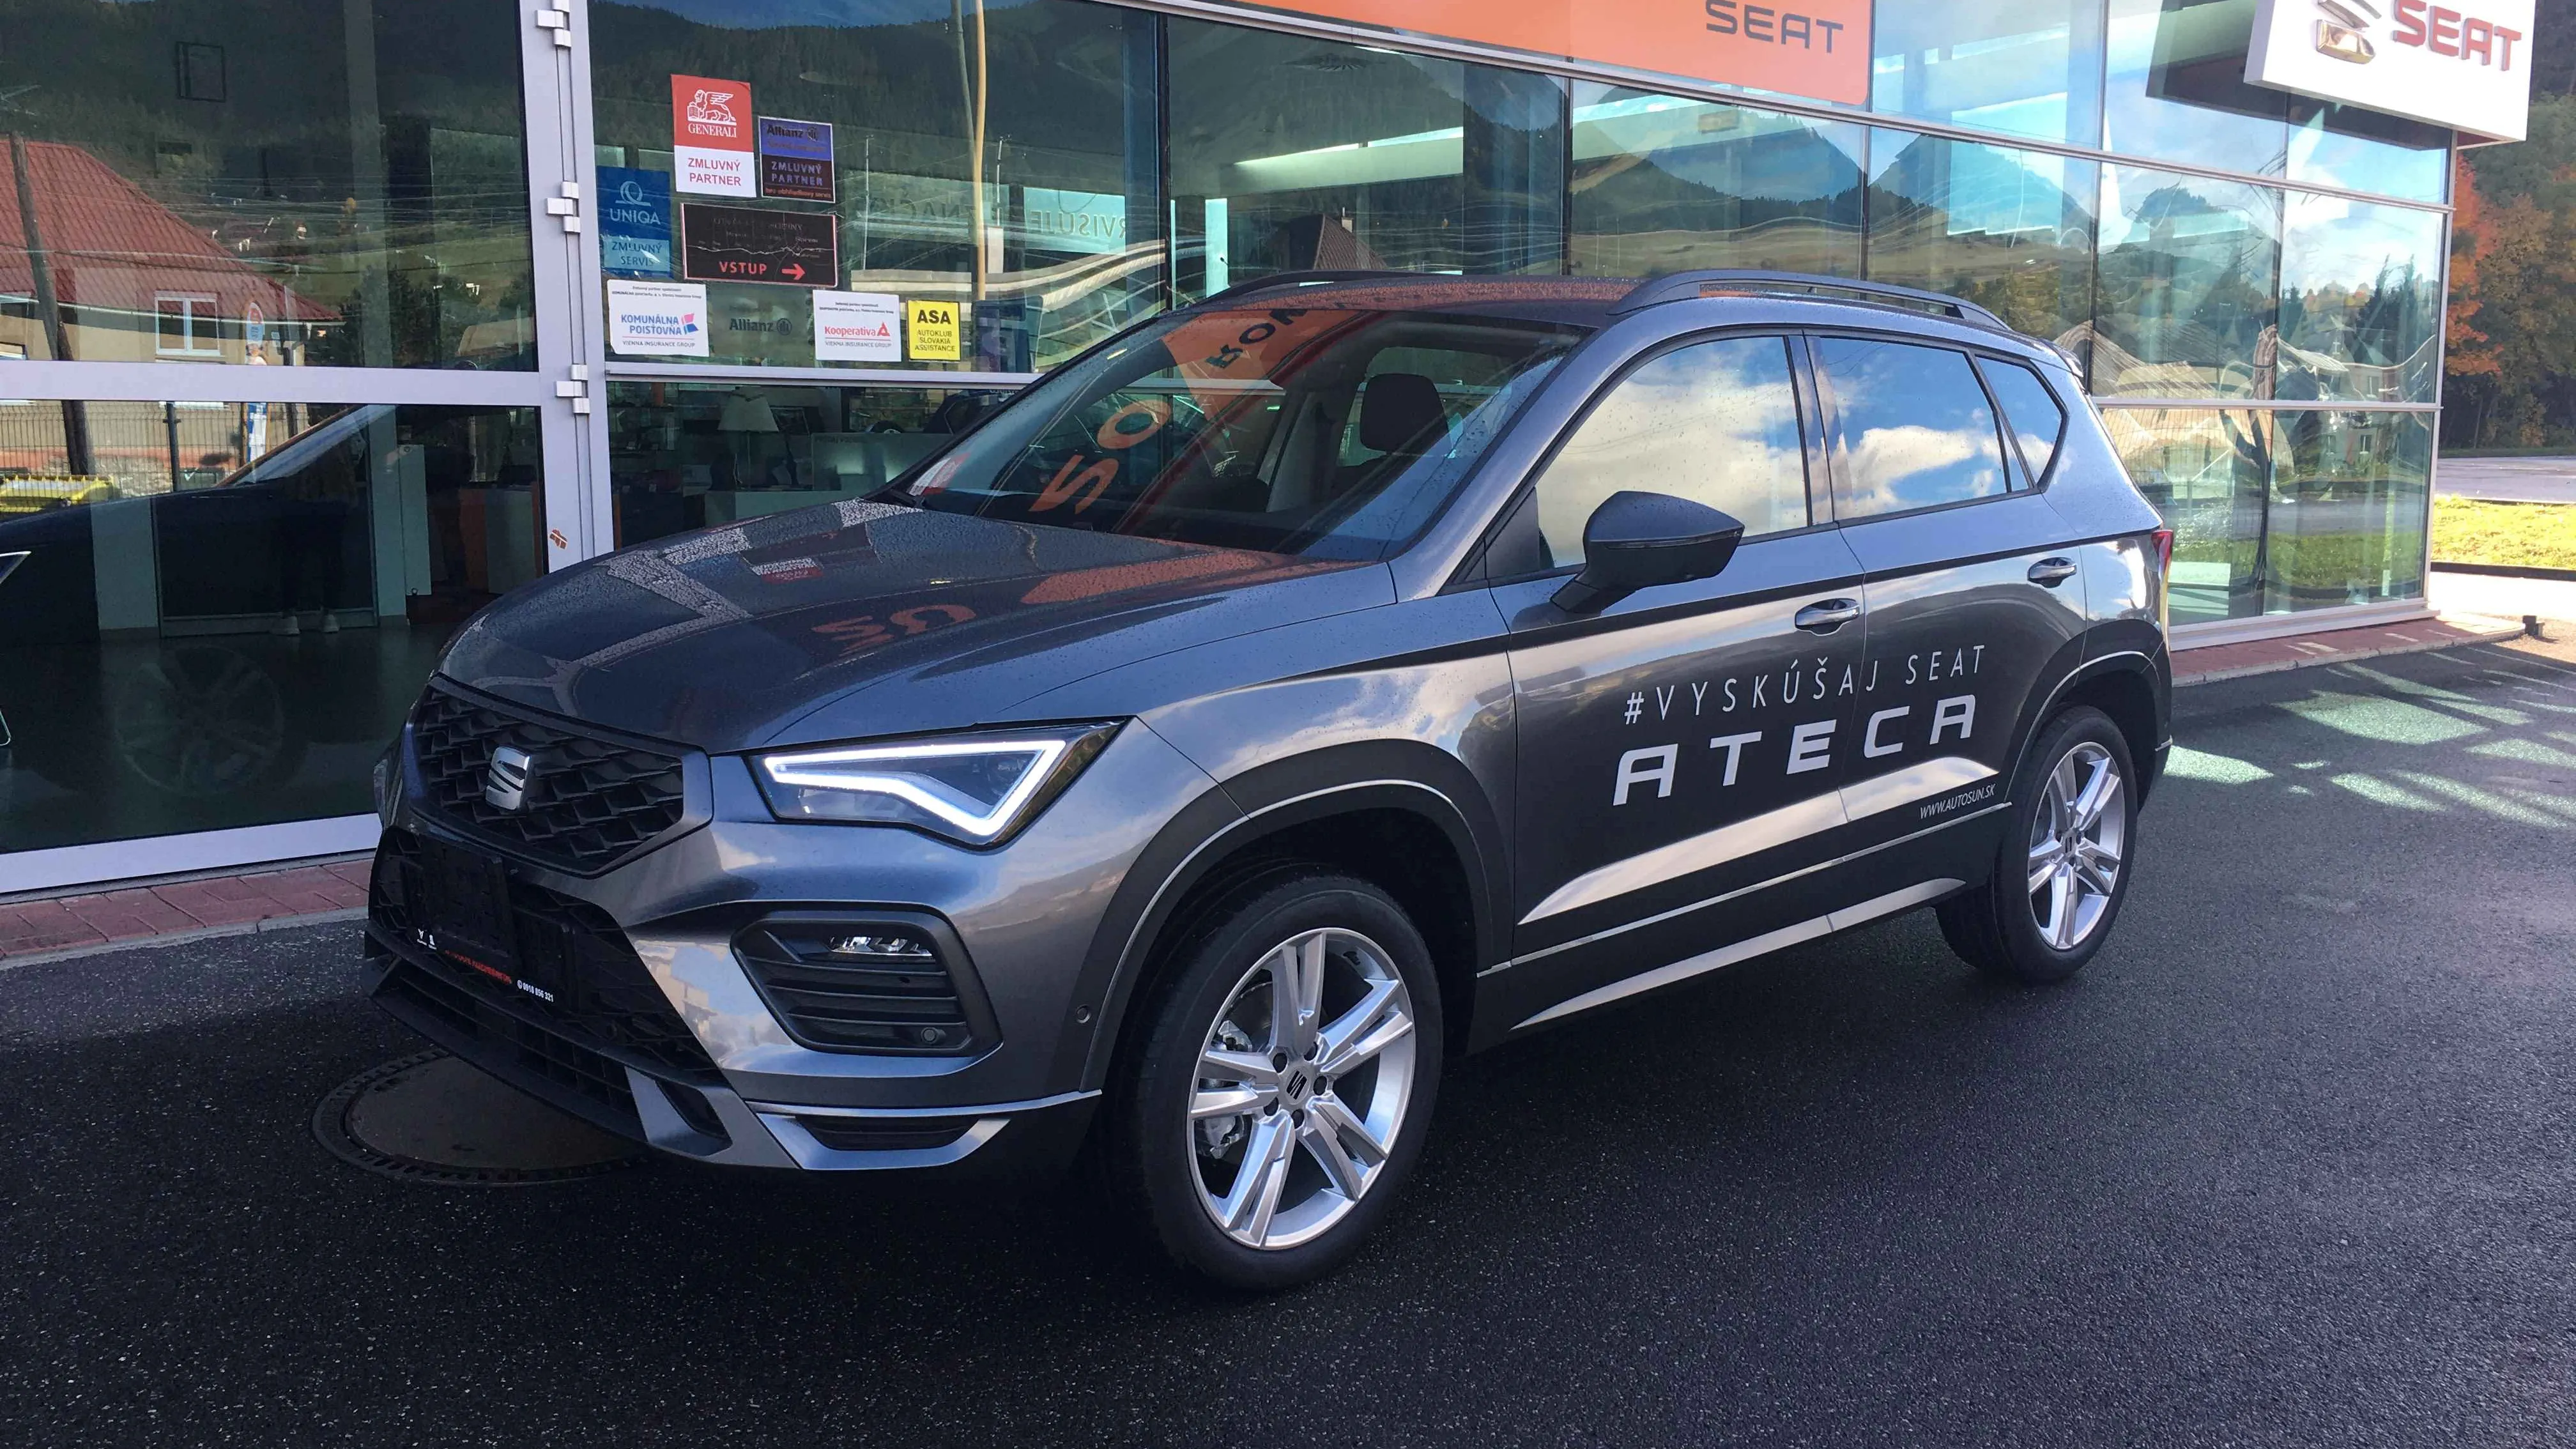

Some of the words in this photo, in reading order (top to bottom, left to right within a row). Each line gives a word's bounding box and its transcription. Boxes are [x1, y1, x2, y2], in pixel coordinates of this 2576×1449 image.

[1706, 0, 1844, 54] SEAT
[2391, 0, 2522, 72] SEAT
[687, 123, 737, 138] GENERALI
[687, 157, 740, 172] ZMLUVNÝ
[771, 161, 822, 174] ZMLUVNÝ
[689, 172, 741, 187] PARTNER
[771, 173, 823, 186] PARTNER
[610, 208, 661, 225] UNIQA
[611, 241, 663, 254] ZMLUVNÝ
[719, 261, 767, 275] VSTUP
[620, 314, 679, 325] KOMUNÁLNA
[917, 309, 952, 325] ASA
[629, 325, 682, 335] POISŤOVŇA
[729, 318, 774, 332] Allianz
[824, 326, 876, 338] Kooperativa
[917, 329, 953, 337] AUTOKLUB
[919, 336, 951, 344] SLOVAKIA
[914, 344, 956, 352] ASSISTANCE
[1624, 656, 1878, 725] #VYSKÚŠAJ
[1905, 644, 1985, 686] SEAT
[1612, 694, 1977, 807] ATECA
[1919, 783, 1997, 820] WWW.AUTOSUN.SK
